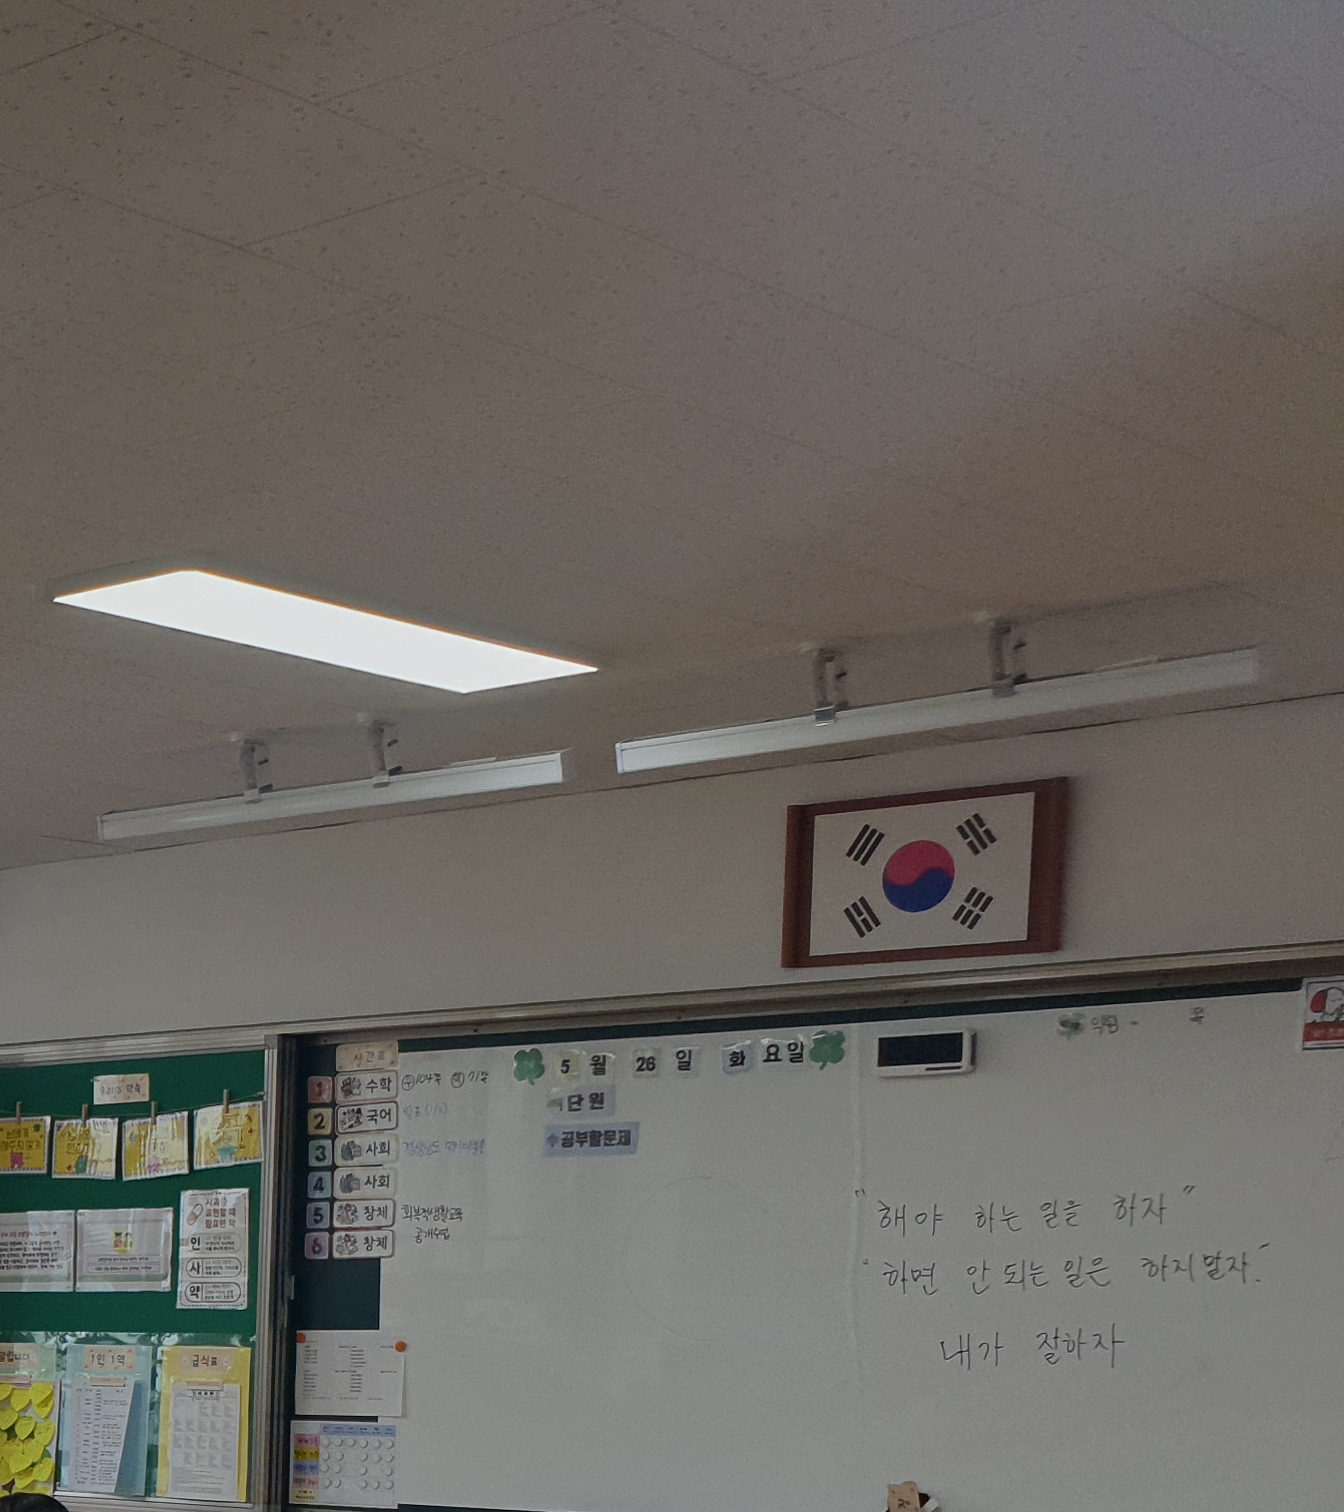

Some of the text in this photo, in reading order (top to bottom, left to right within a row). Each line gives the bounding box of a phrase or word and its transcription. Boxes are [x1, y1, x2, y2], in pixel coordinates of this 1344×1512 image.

[560, 1060, 570, 1074] 5
[590, 1055, 606, 1076] 월
[635, 1056, 656, 1072] 26
[675, 1049, 692, 1072] 일
[729, 1050, 746, 1068] 화
[365, 1077, 392, 1094] 수학
[314, 1108, 392, 1130] 2 국어
[315, 1141, 391, 1162] 3 사회
[313, 1175, 390, 1193] 4 사회
[314, 1204, 388, 1223] 5 창체
[975, 1202, 1022, 1234] 하는
[1040, 1199, 1082, 1229] 일을
[190, 1236, 201, 1251] 인
[364, 1235, 388, 1251] 창체
[189, 1261, 201, 1275] 사
[967, 1259, 990, 1295] 안
[1003, 1260, 1050, 1292] 되는
[1063, 1256, 1111, 1289] 일은
[189, 1285, 201, 1299] 약
[939, 1323, 1126, 1372] 내가 잘하자
[91, 1354, 126, 1367] 1인 1역
[192, 1354, 219, 1368] 급식표
